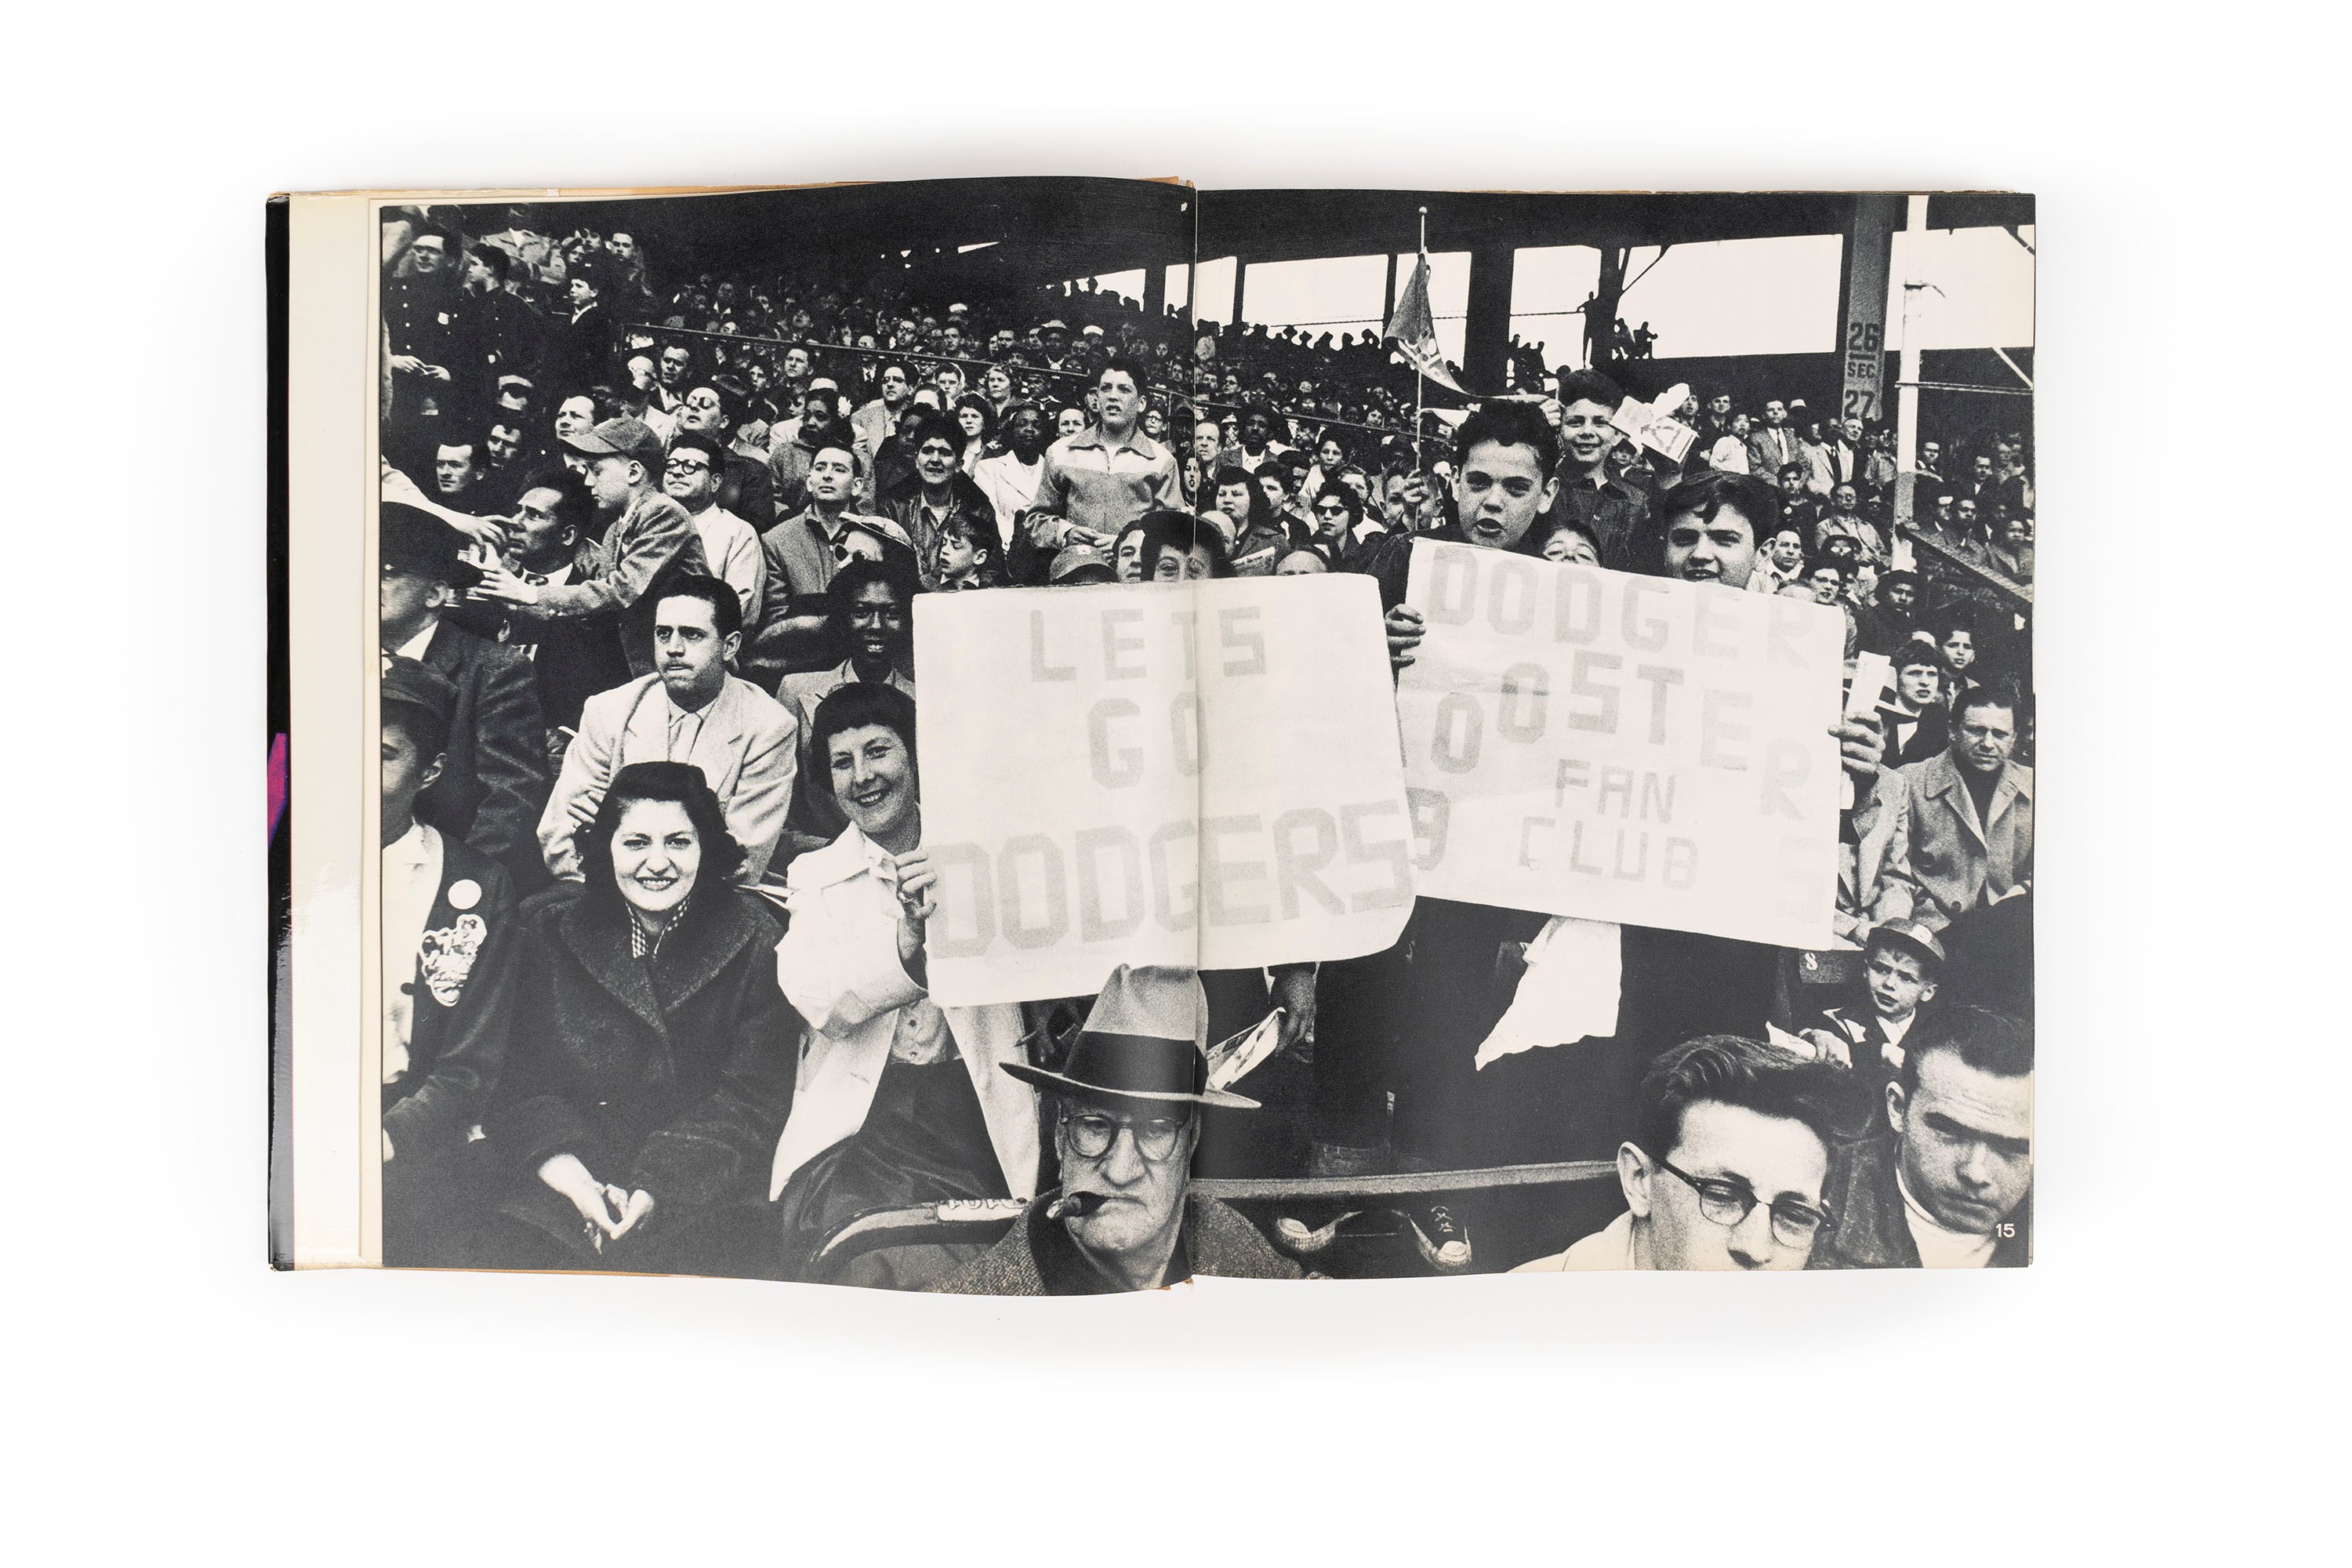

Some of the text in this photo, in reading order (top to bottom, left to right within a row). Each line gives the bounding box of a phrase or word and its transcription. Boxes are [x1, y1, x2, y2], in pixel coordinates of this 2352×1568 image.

[1847, 361, 1877, 379] SEC
[1848, 322, 1879, 352] 26
[1844, 390, 1875, 419] 27
[1428, 543, 1815, 670] DODGER
[1029, 605, 1268, 681] LETS
[1087, 691, 1210, 789] GO
[1555, 758, 1677, 825] FAN
[927, 799, 1414, 959] DODGERS
[1518, 815, 1700, 890] CLUB
[1995, 1223, 2016, 1239] 15
